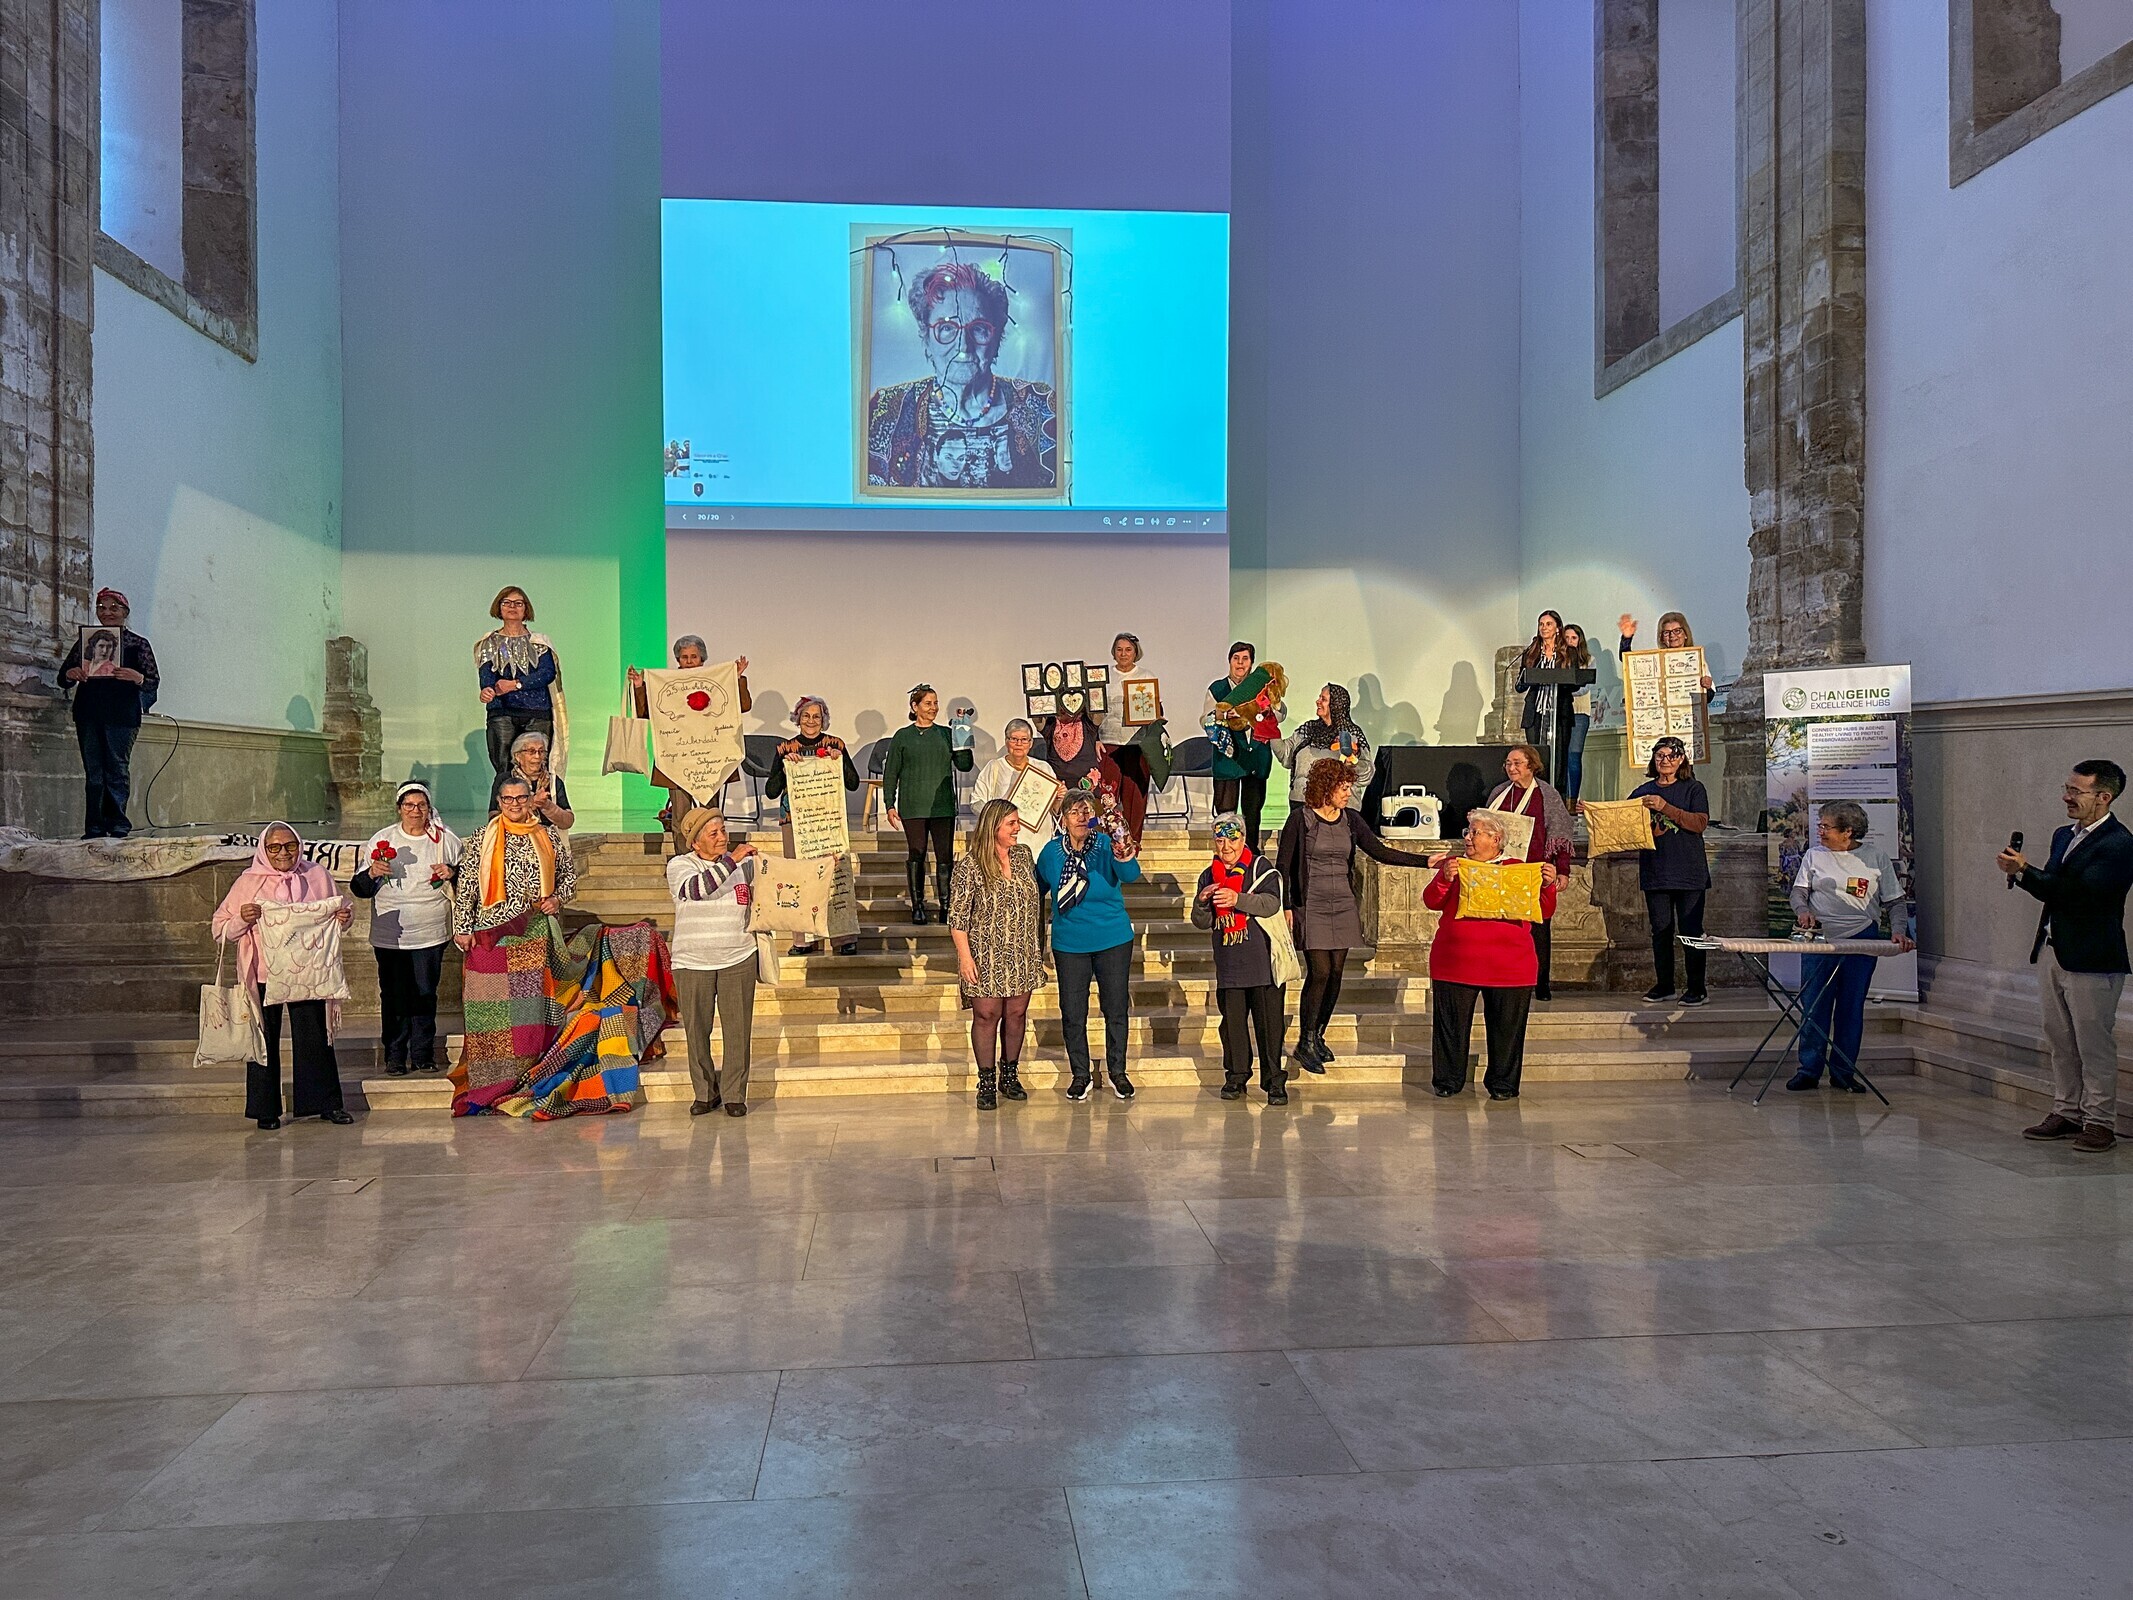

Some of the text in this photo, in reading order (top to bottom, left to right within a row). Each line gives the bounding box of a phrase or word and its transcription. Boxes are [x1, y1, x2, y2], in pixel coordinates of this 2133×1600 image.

[1811, 688, 1890, 701] CHANGEING
[1811, 699, 1890, 709] EXCELLENCE HUBS
